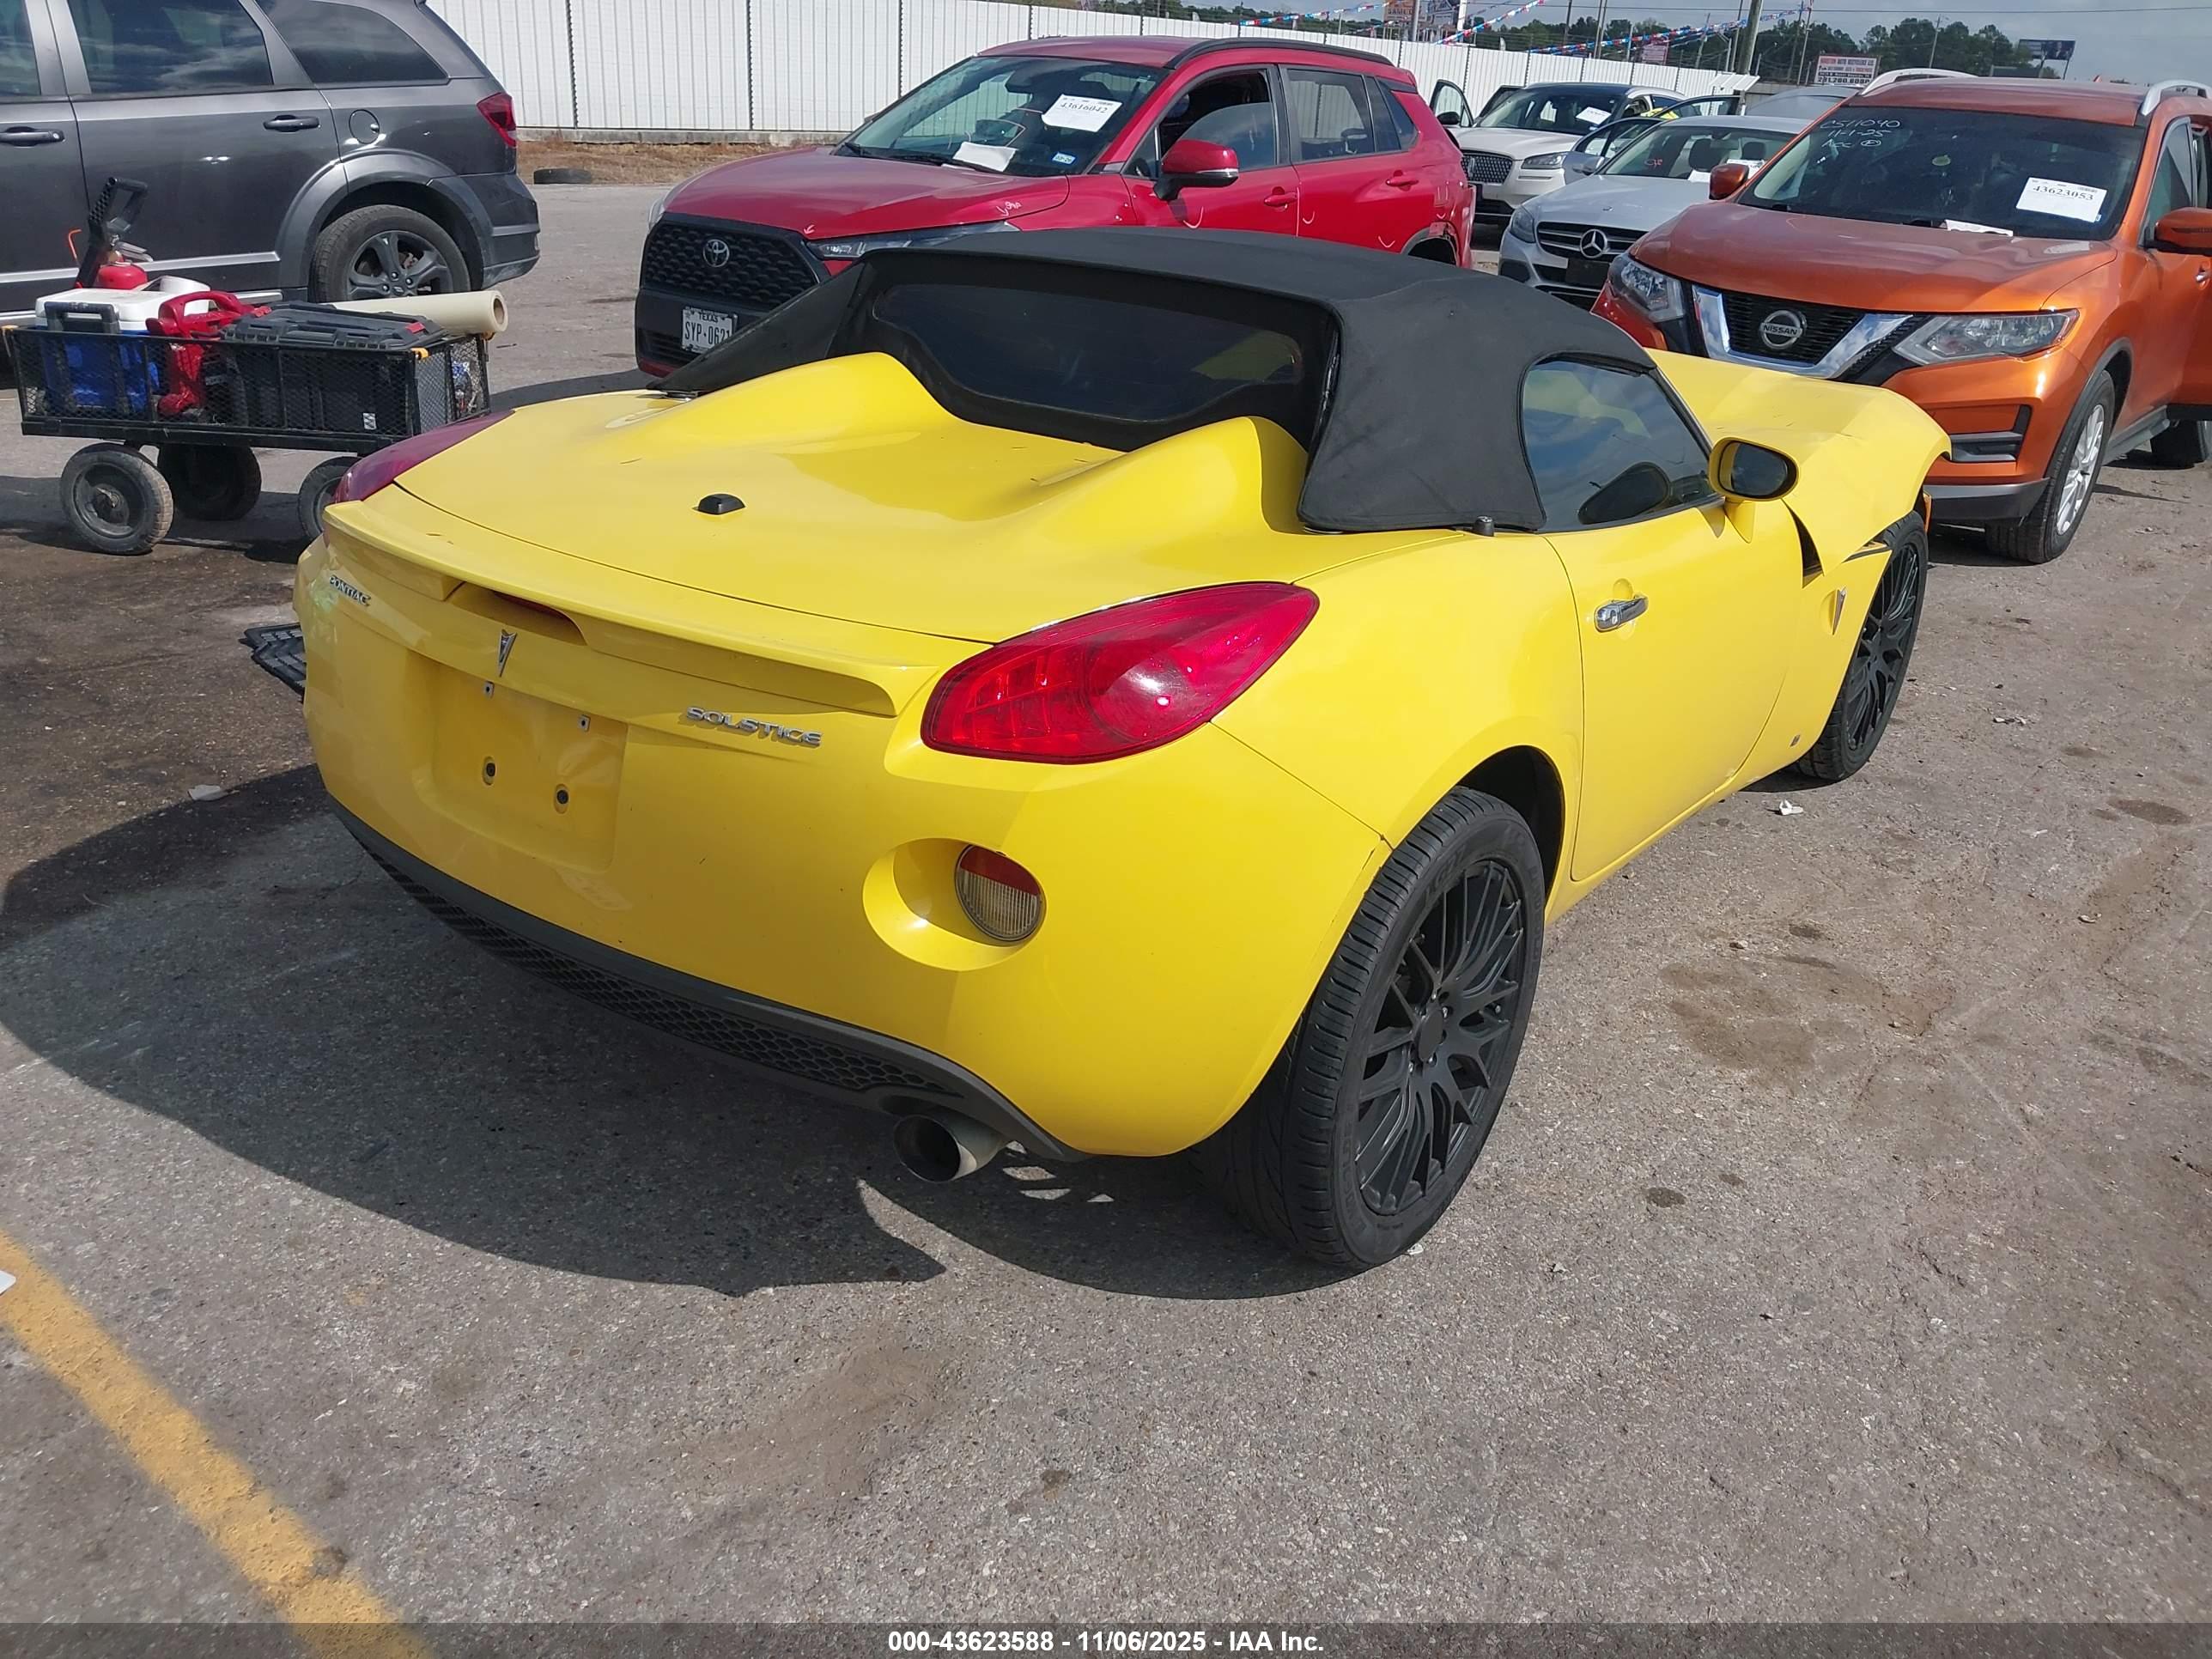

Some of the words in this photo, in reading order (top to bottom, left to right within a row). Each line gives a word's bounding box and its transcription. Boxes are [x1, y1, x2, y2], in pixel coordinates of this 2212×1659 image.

[1060, 102, 1108, 113] 43616042
[2032, 185, 2095, 201] 43623053
[698, 311, 719, 323] TEXAS
[1763, 325, 1798, 336] NISSAN
[329, 574, 371, 606] PONTIAC
[686, 706, 822, 745] SOLSTICE
